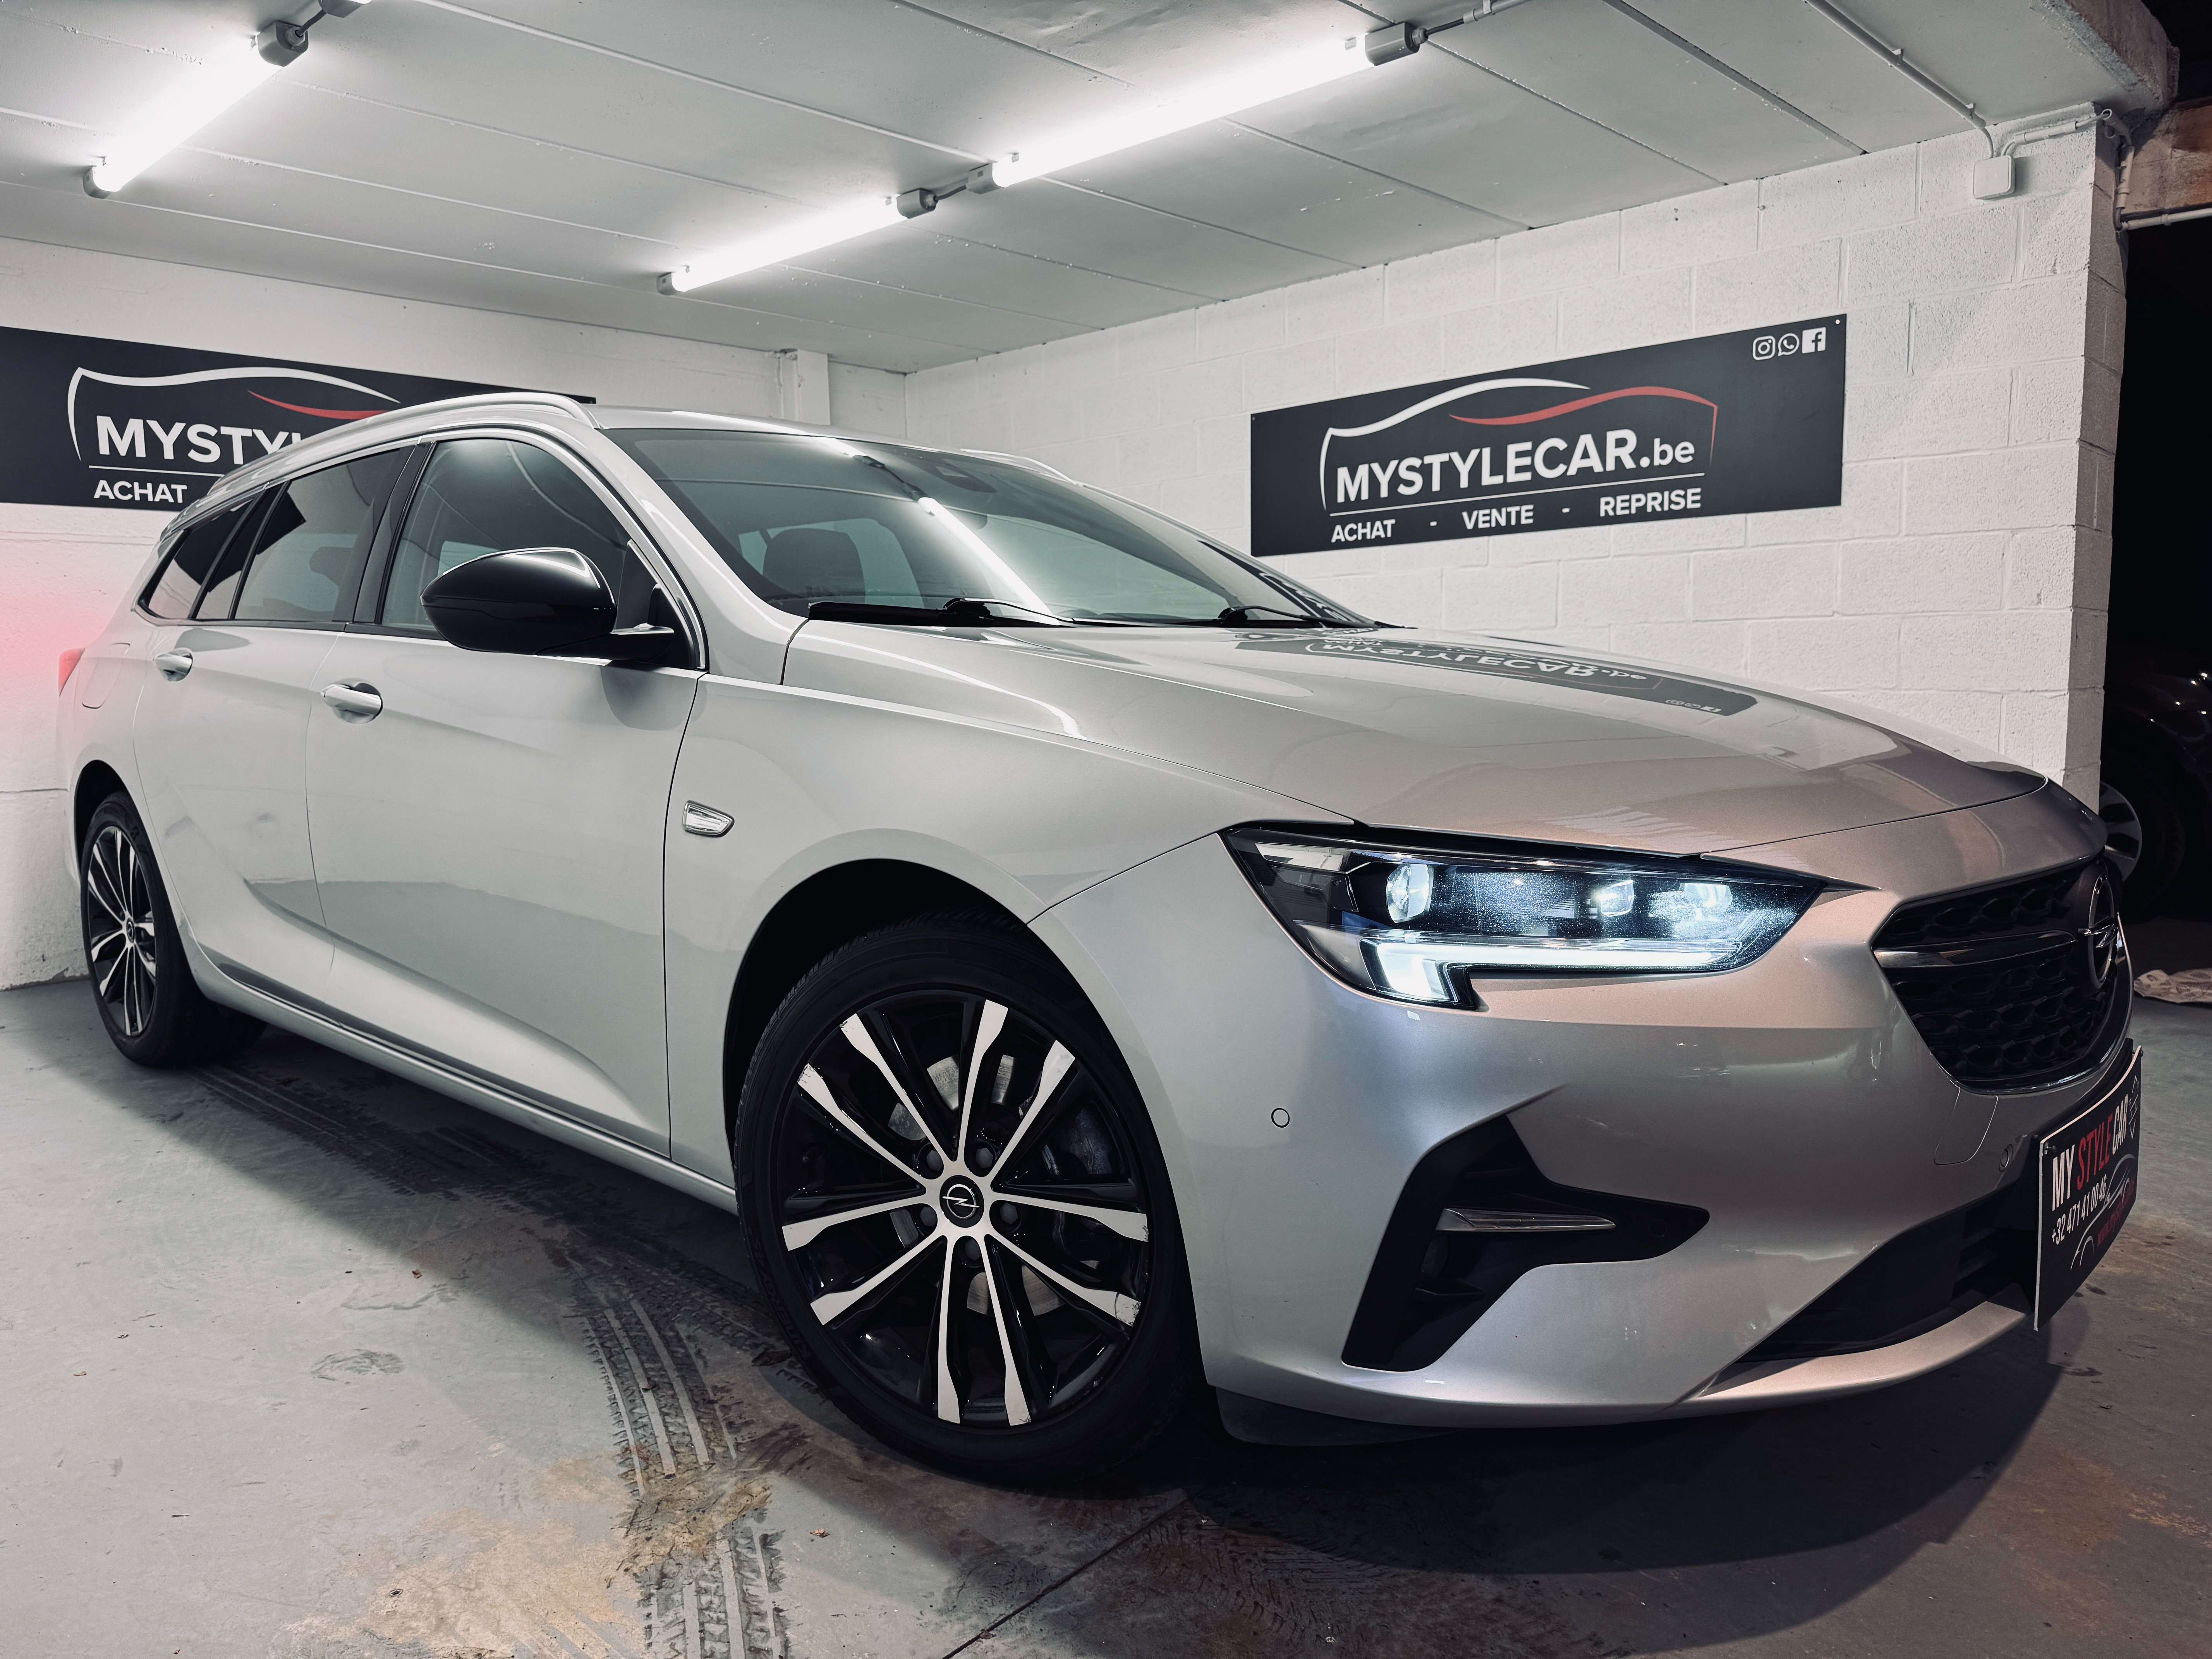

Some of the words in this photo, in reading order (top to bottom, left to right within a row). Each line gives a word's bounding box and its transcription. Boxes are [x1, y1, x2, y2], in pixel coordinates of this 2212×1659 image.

[94, 480, 187, 503] ACHAT
[1337, 429, 1695, 503] MYSTYLECAR.be
[1331, 519, 1396, 543] ACHAT
[1462, 505, 1534, 530] VENTE
[1600, 488, 1701, 517] REPRISE
[2052, 1144, 2075, 1211] MY
[2077, 1113, 2113, 1190] STYLE
[2112, 1094, 2128, 1155] CAR
[2052, 1213, 2066, 1245] +32
[2066, 1200, 2080, 1234] 471
[2081, 1191, 2090, 1220] 41
[2090, 1183, 2099, 1212] 00
[2099, 1174, 2107, 1202] 46
